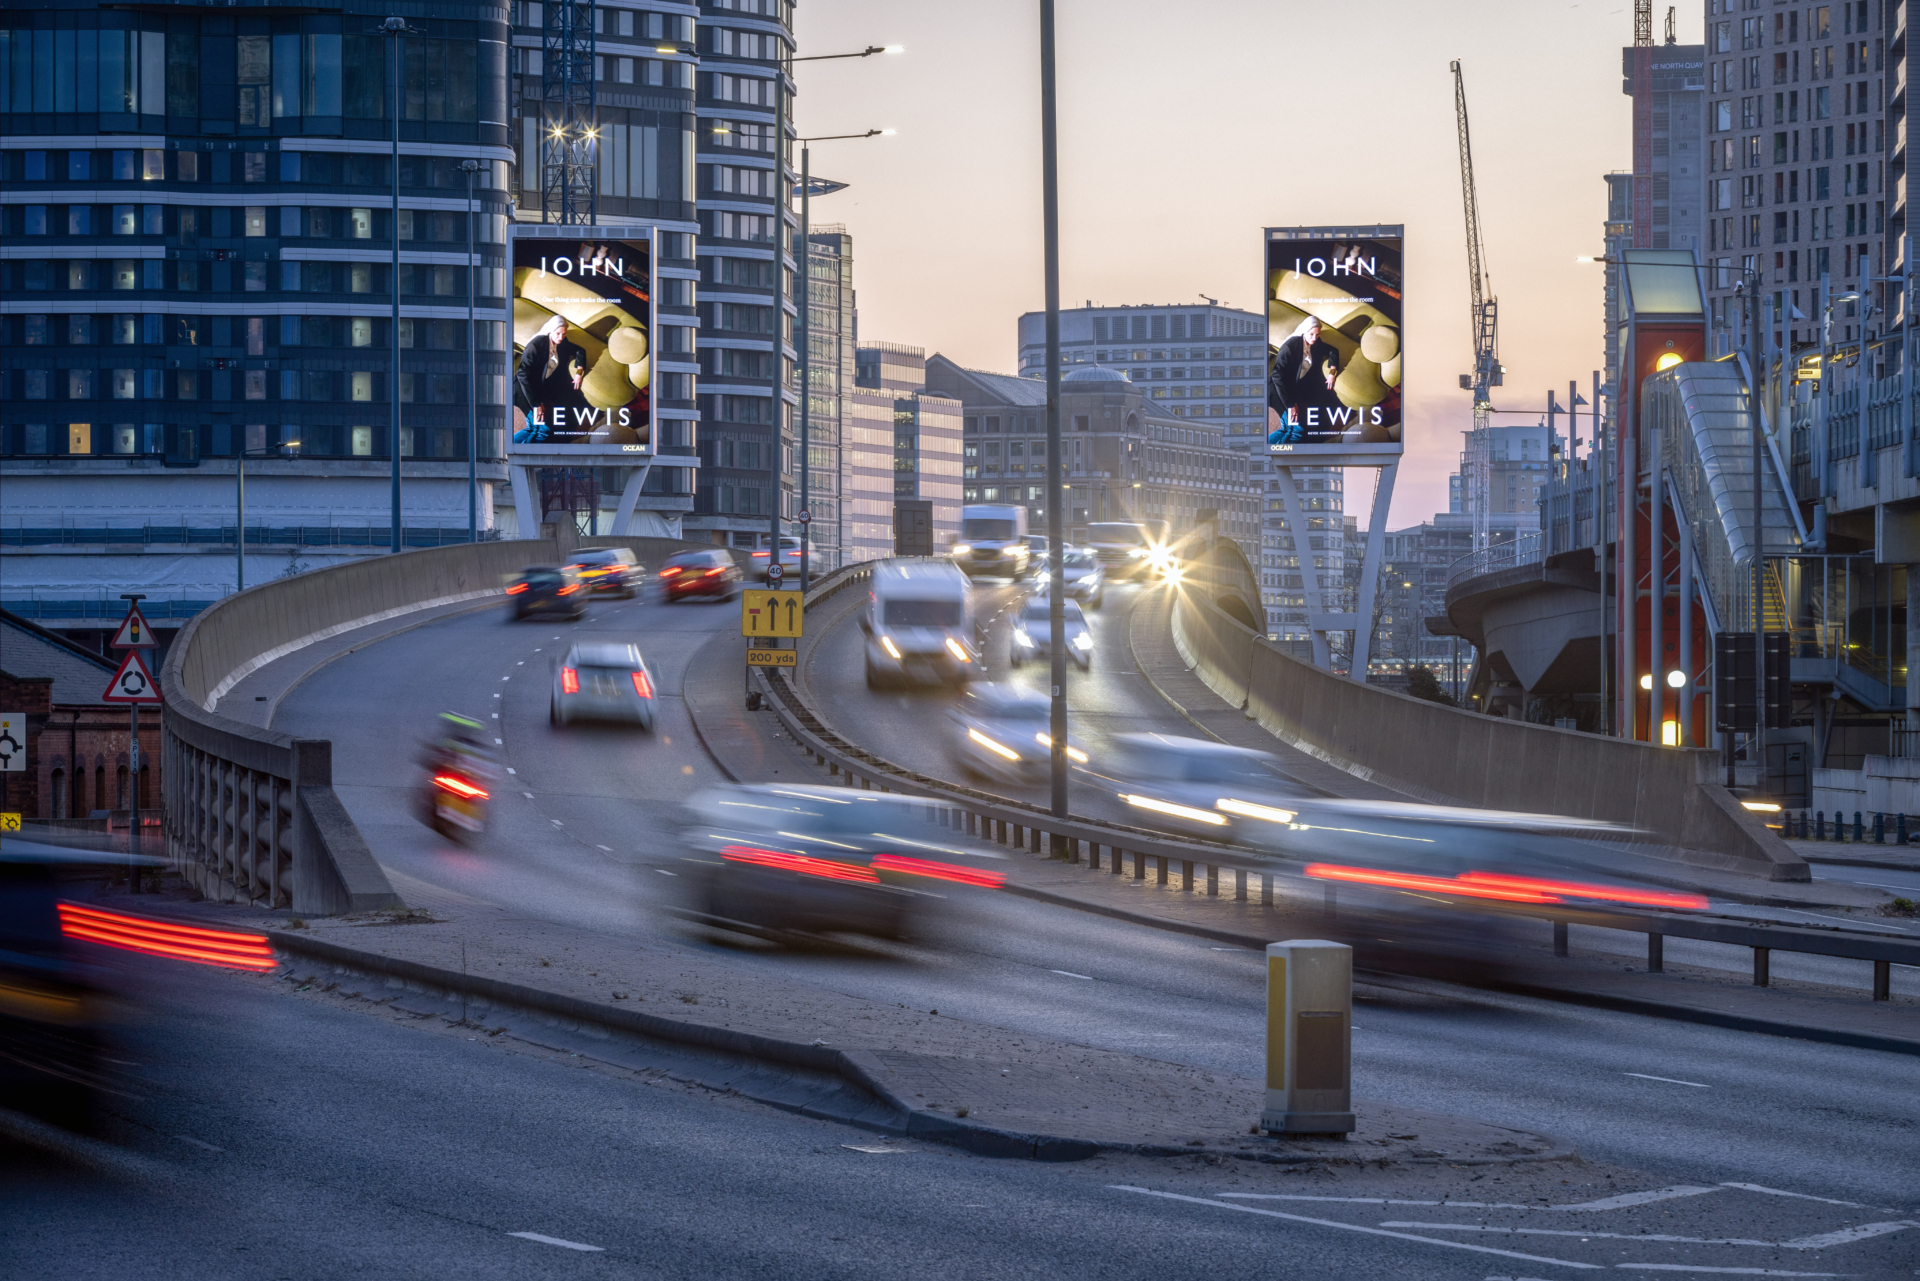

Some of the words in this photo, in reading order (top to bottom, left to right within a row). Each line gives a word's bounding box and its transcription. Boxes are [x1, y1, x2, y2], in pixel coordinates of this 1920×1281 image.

[539, 256, 623, 278] JOHN
[1293, 256, 1376, 280] JOHN
[1813, 382, 1818, 390] 2
[533, 407, 630, 426] LEWIS
[1287, 406, 1382, 426] LEWIS
[750, 653, 772, 662] 200
[776, 654, 794, 664] yds
